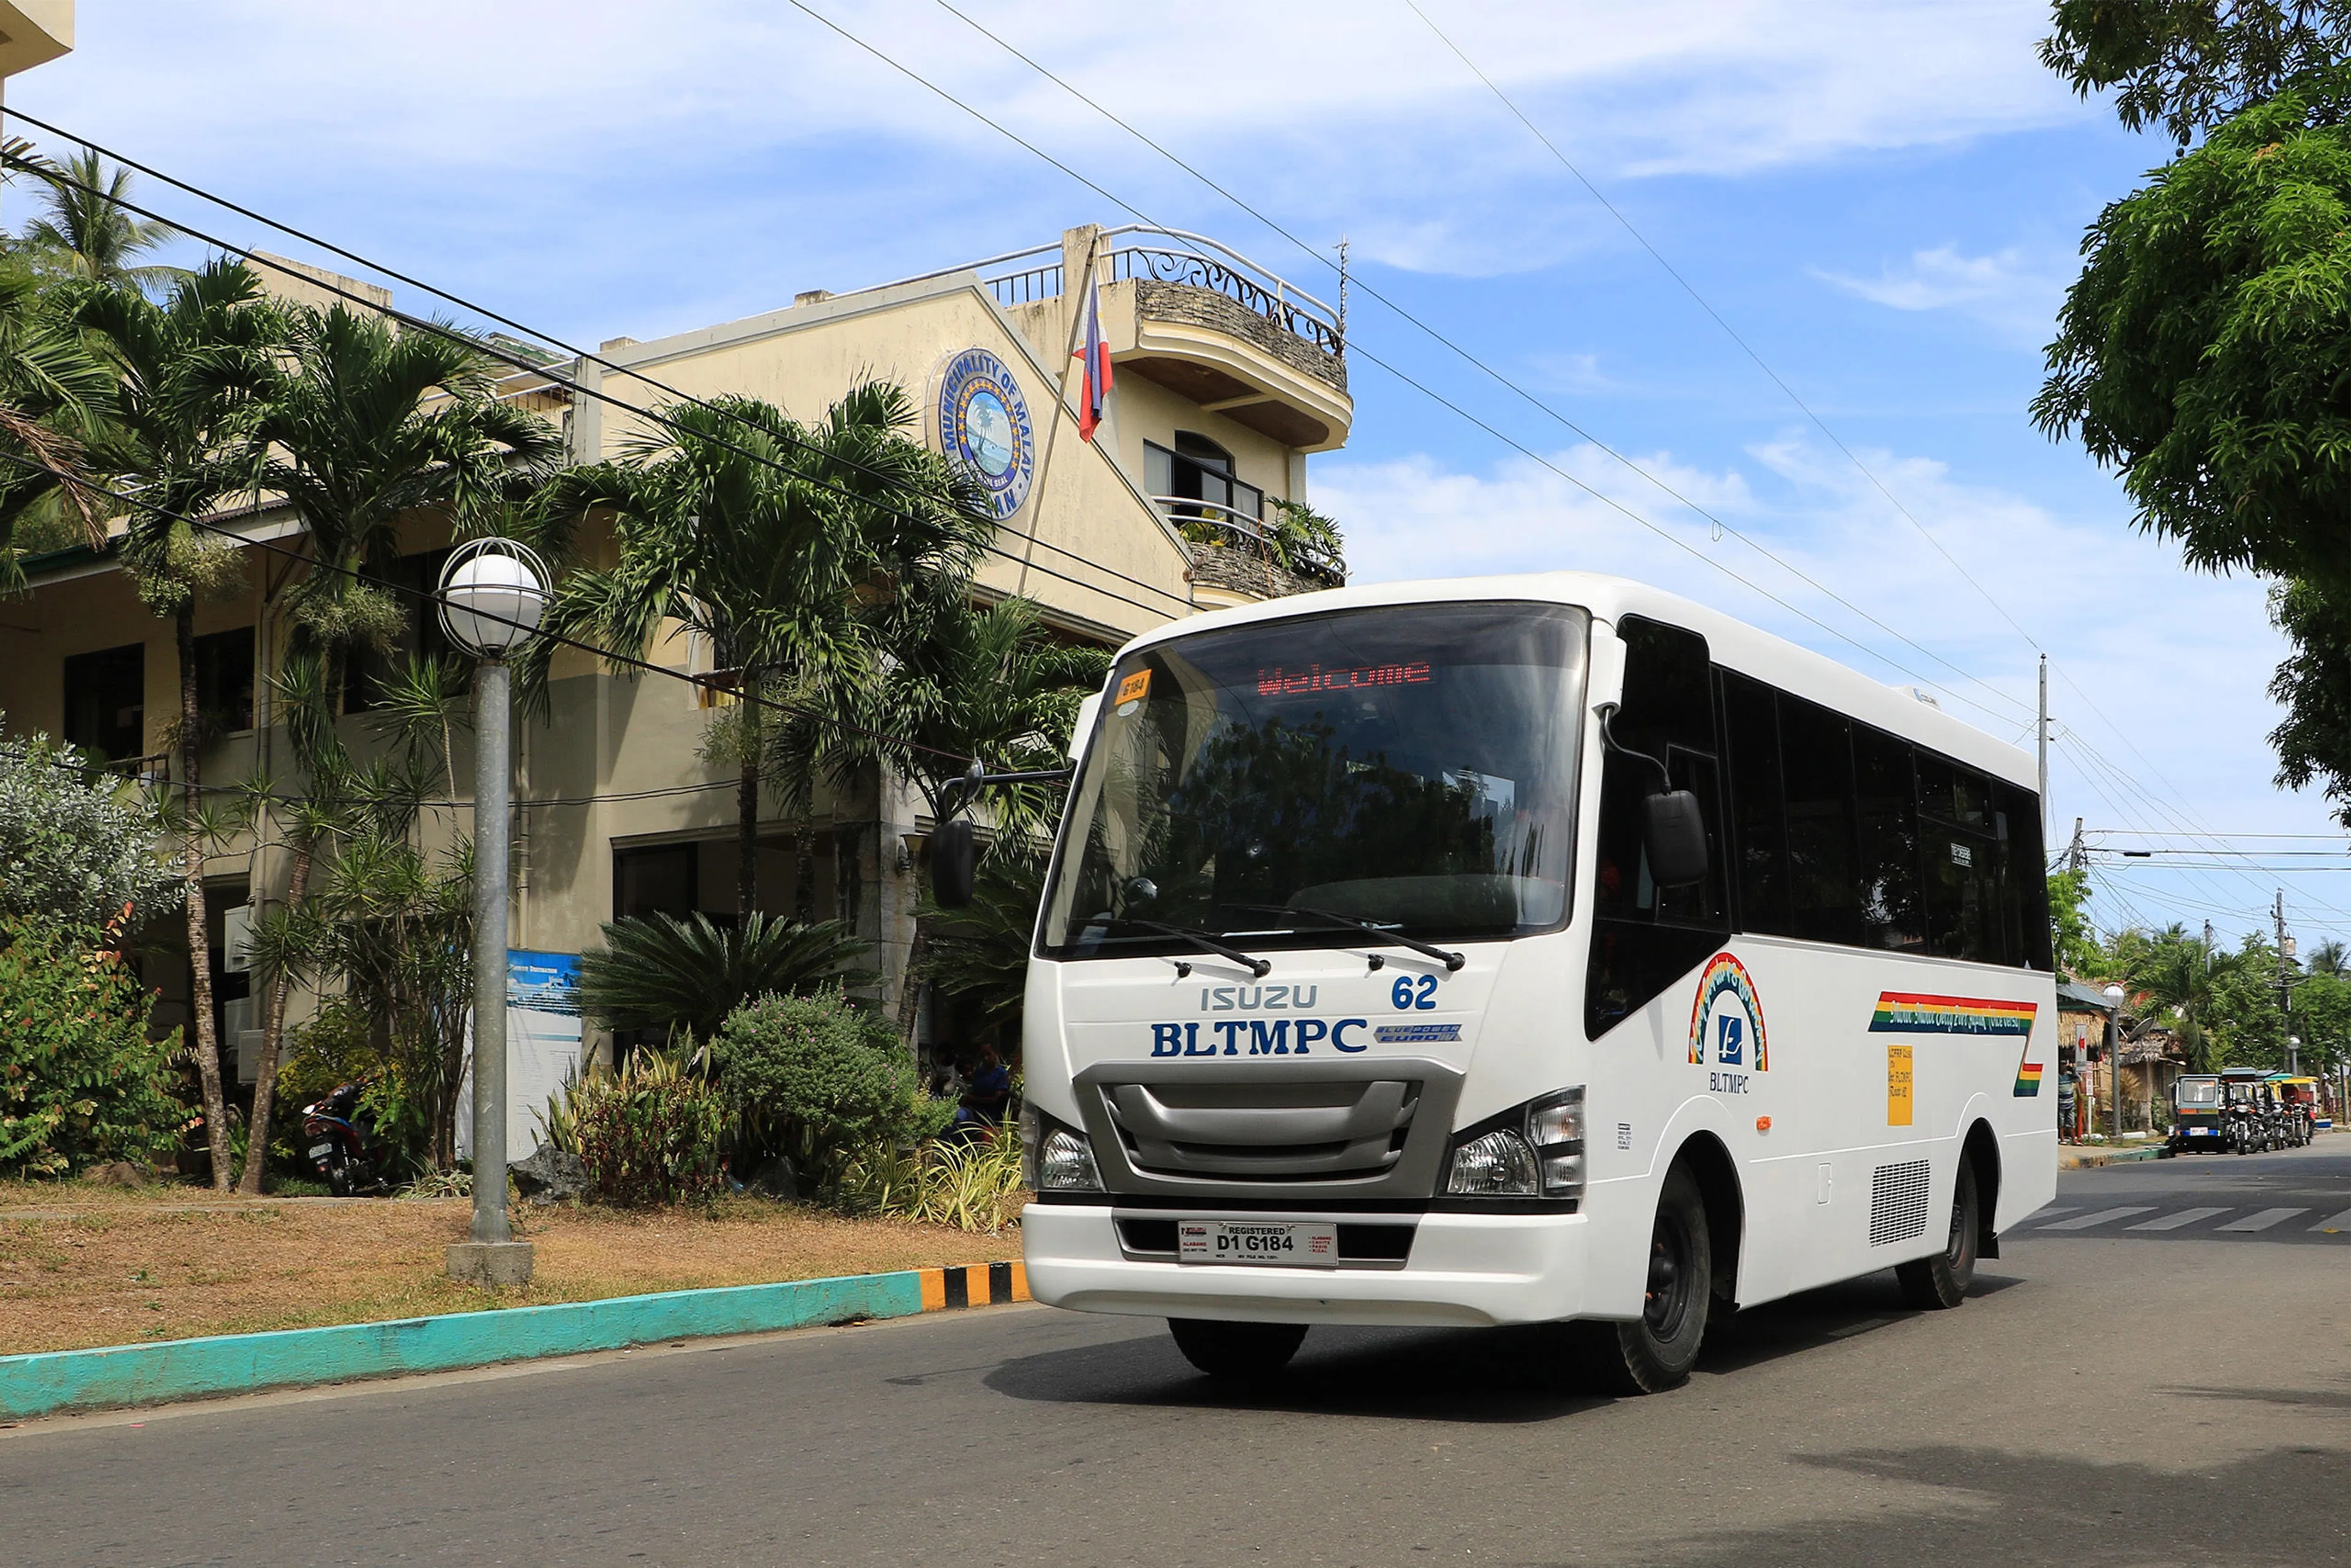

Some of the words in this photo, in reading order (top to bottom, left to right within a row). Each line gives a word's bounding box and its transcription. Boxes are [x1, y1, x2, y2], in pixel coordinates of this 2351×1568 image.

[943, 354, 999, 451] MUNICIPALITY
[1000, 373, 1017, 396] OF
[1014, 400, 1031, 481] MALAY
[1258, 661, 1430, 696] Welcome
[1201, 985, 1318, 1011] ISUZU
[1391, 974, 1438, 1010] 62
[1150, 1018, 1368, 1057] BLTMPC
[1709, 1071, 1749, 1094] BLTMPC
[1217, 1235, 1240, 1250] D1
[1245, 1236, 1294, 1251] G184
[1229, 1226, 1285, 1236] REGISTERED
